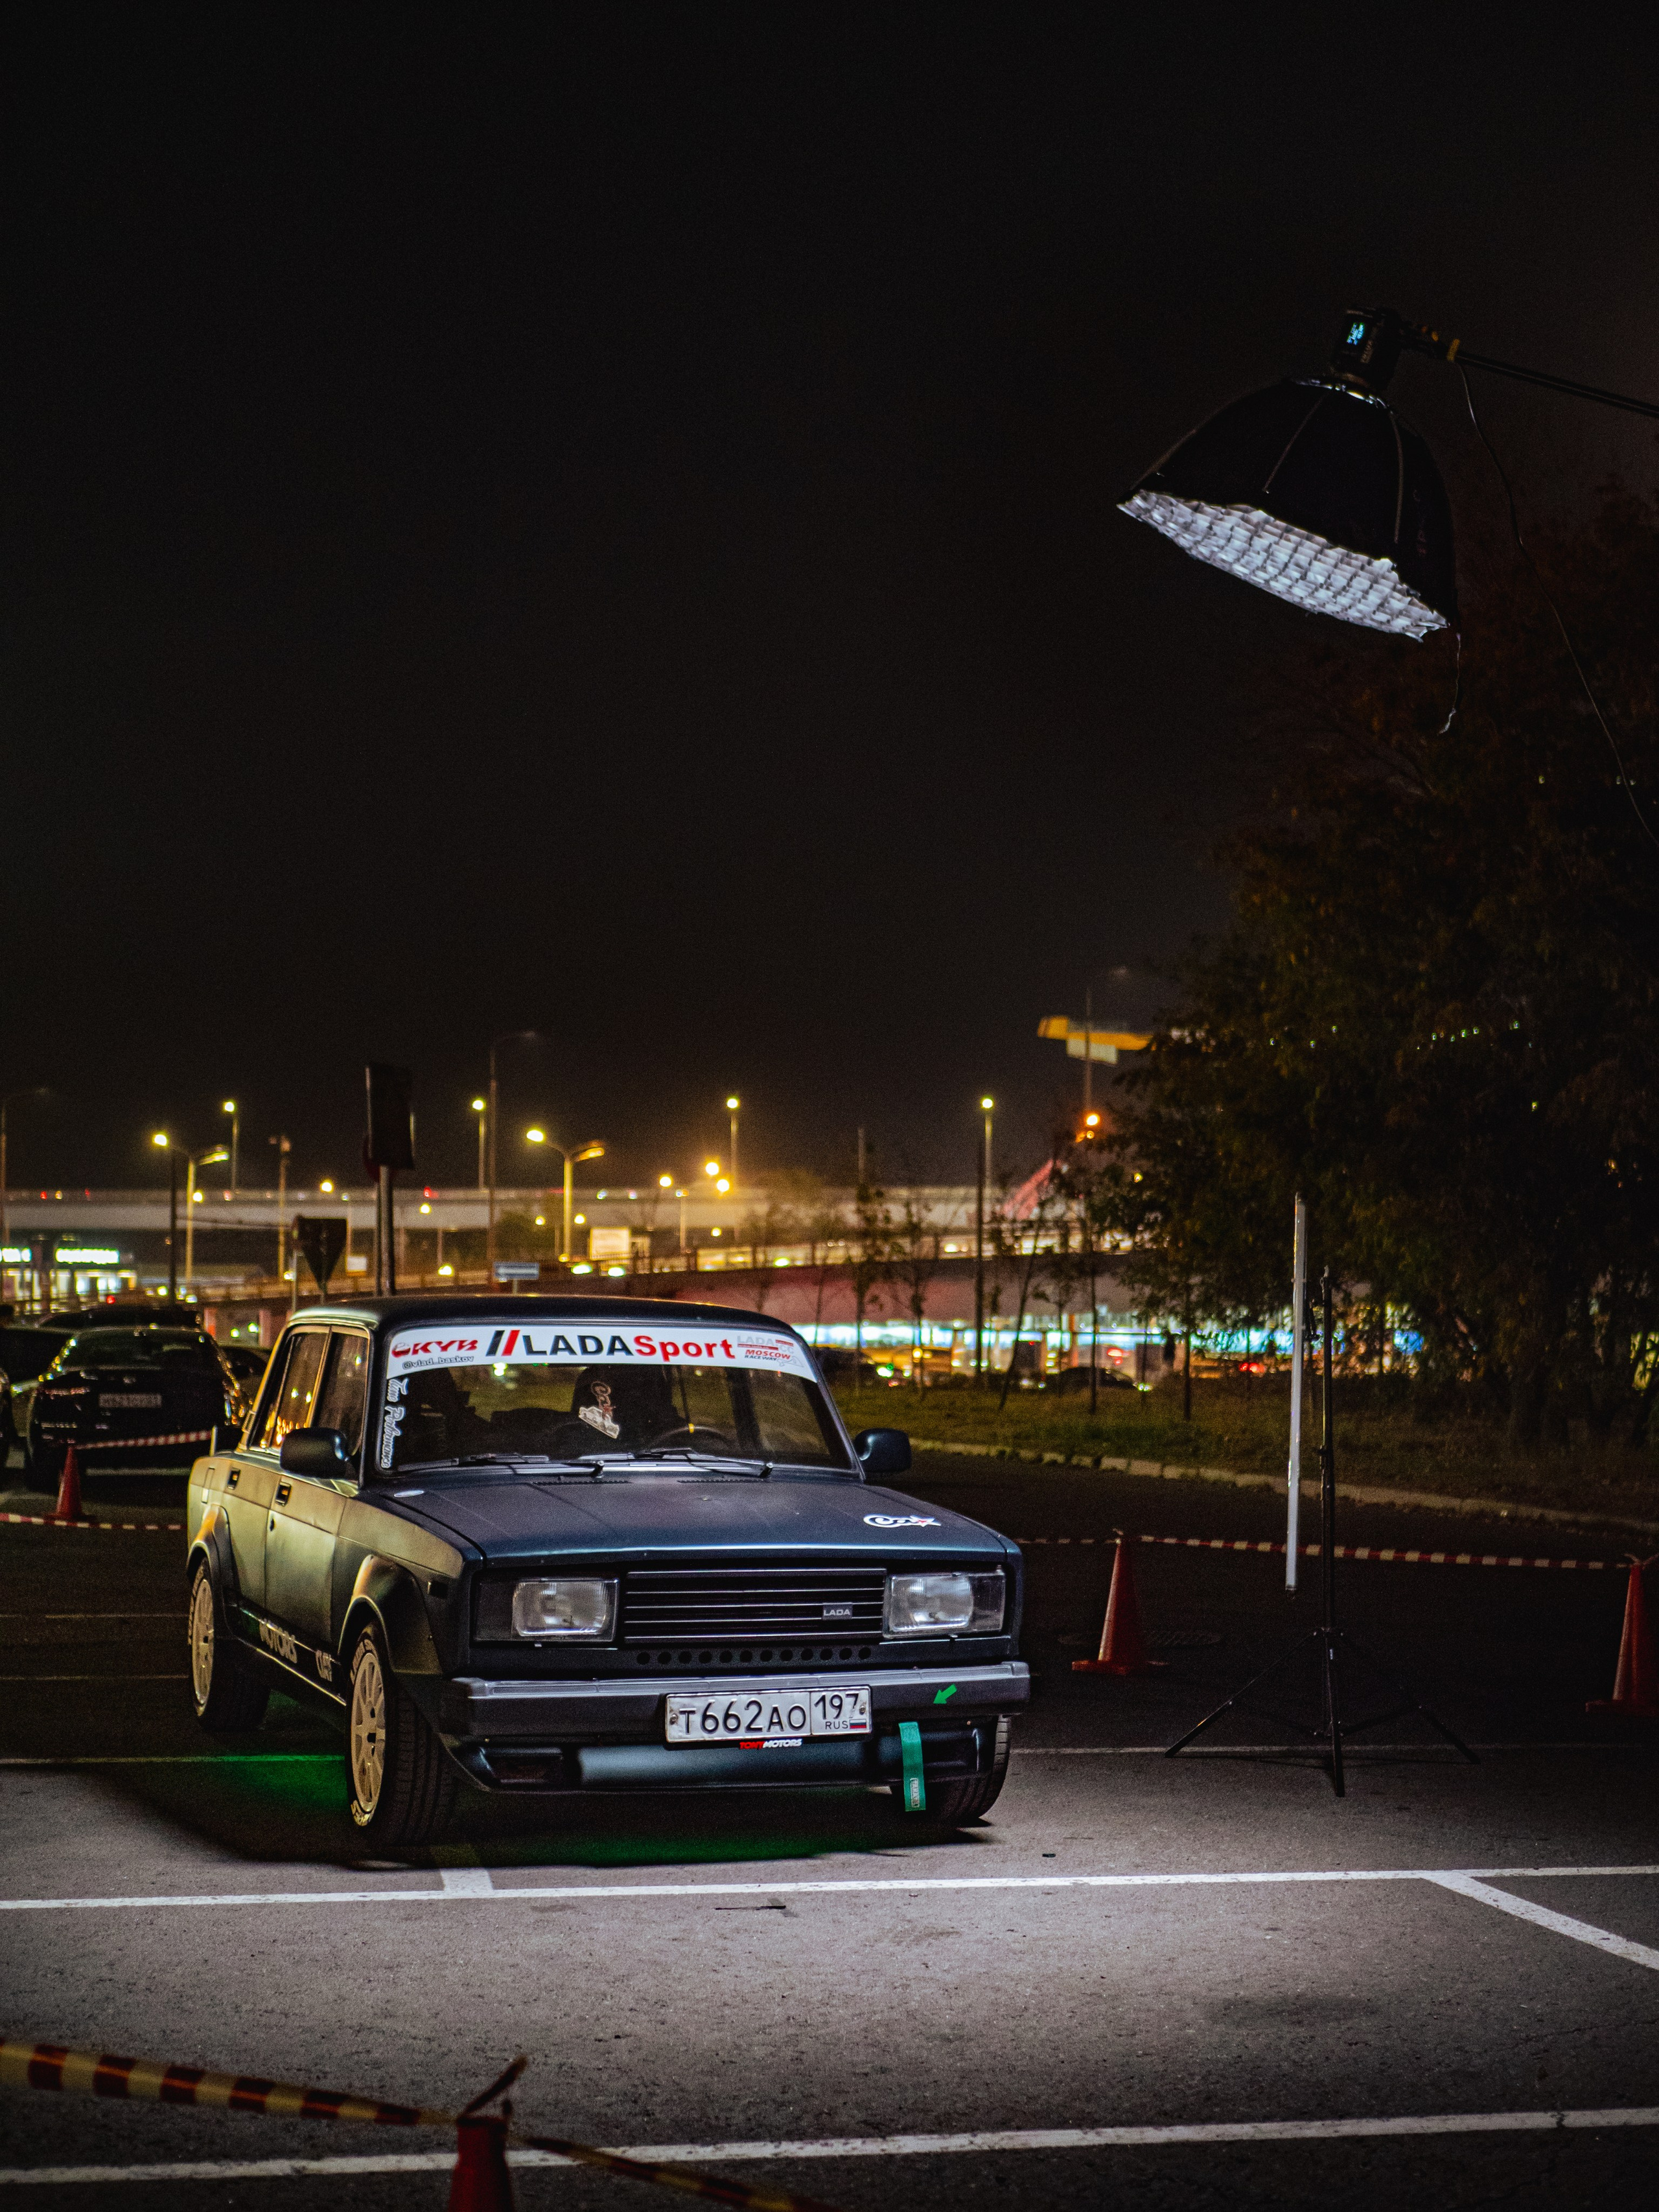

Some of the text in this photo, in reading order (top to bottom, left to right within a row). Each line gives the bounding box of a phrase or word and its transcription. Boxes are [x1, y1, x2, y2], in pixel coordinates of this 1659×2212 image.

[412, 1339, 478, 1355] KYB
[745, 1349, 791, 1360] MOSCOW
[814, 1692, 859, 1719] 197
[825, 1719, 848, 1730] RUS
